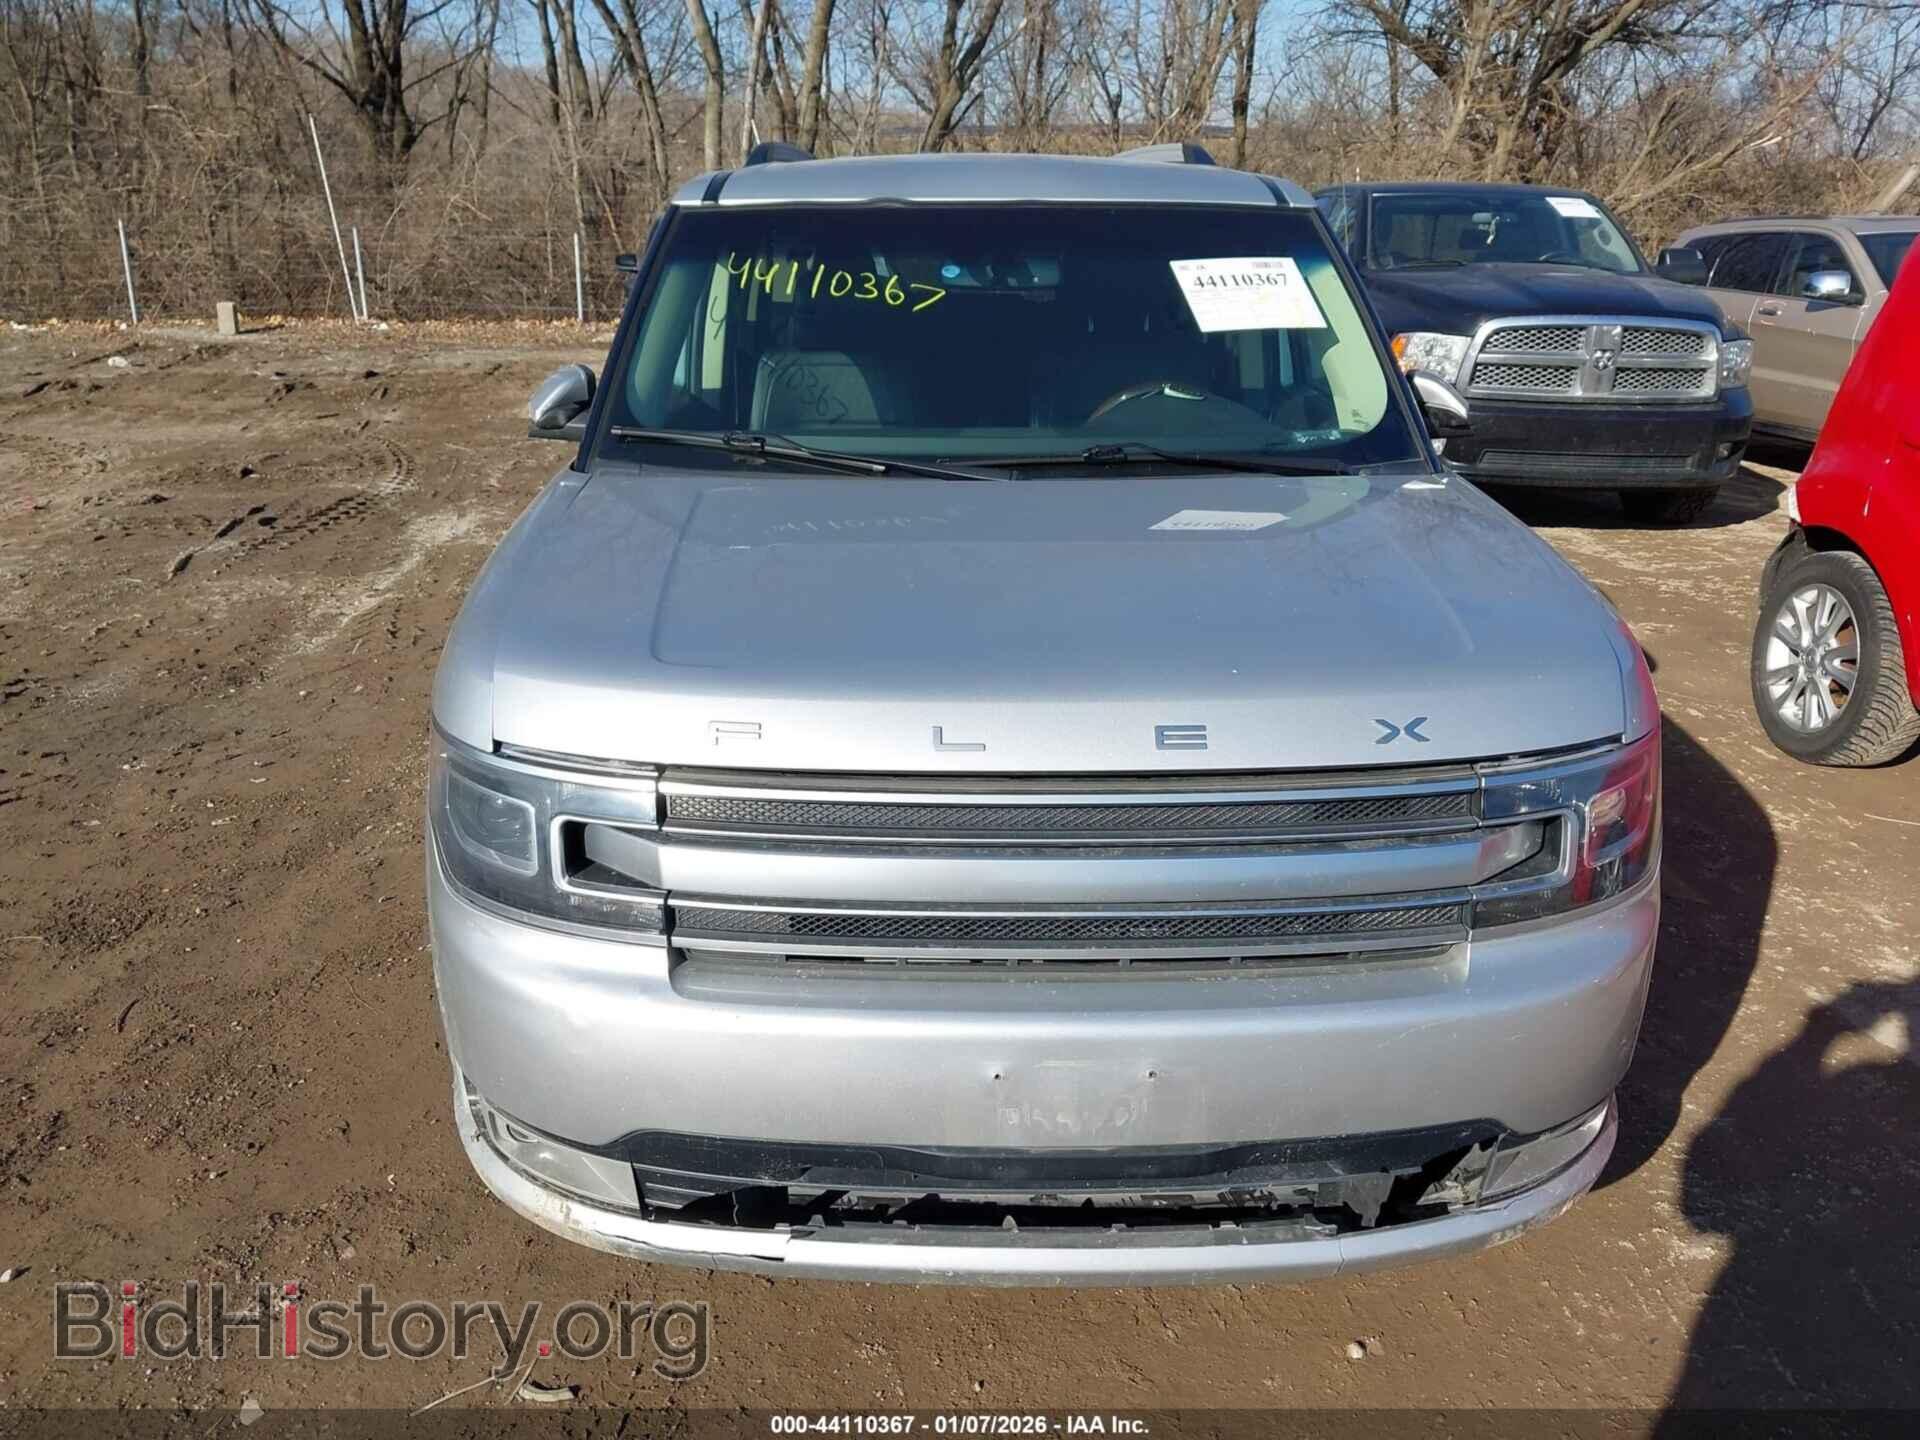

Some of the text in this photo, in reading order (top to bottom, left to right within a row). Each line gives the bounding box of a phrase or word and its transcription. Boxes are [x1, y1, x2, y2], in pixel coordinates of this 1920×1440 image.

[726, 251, 947, 312] 44110367
[1193, 272, 1288, 289] 44110367
[708, 715, 1431, 753] FLEX
